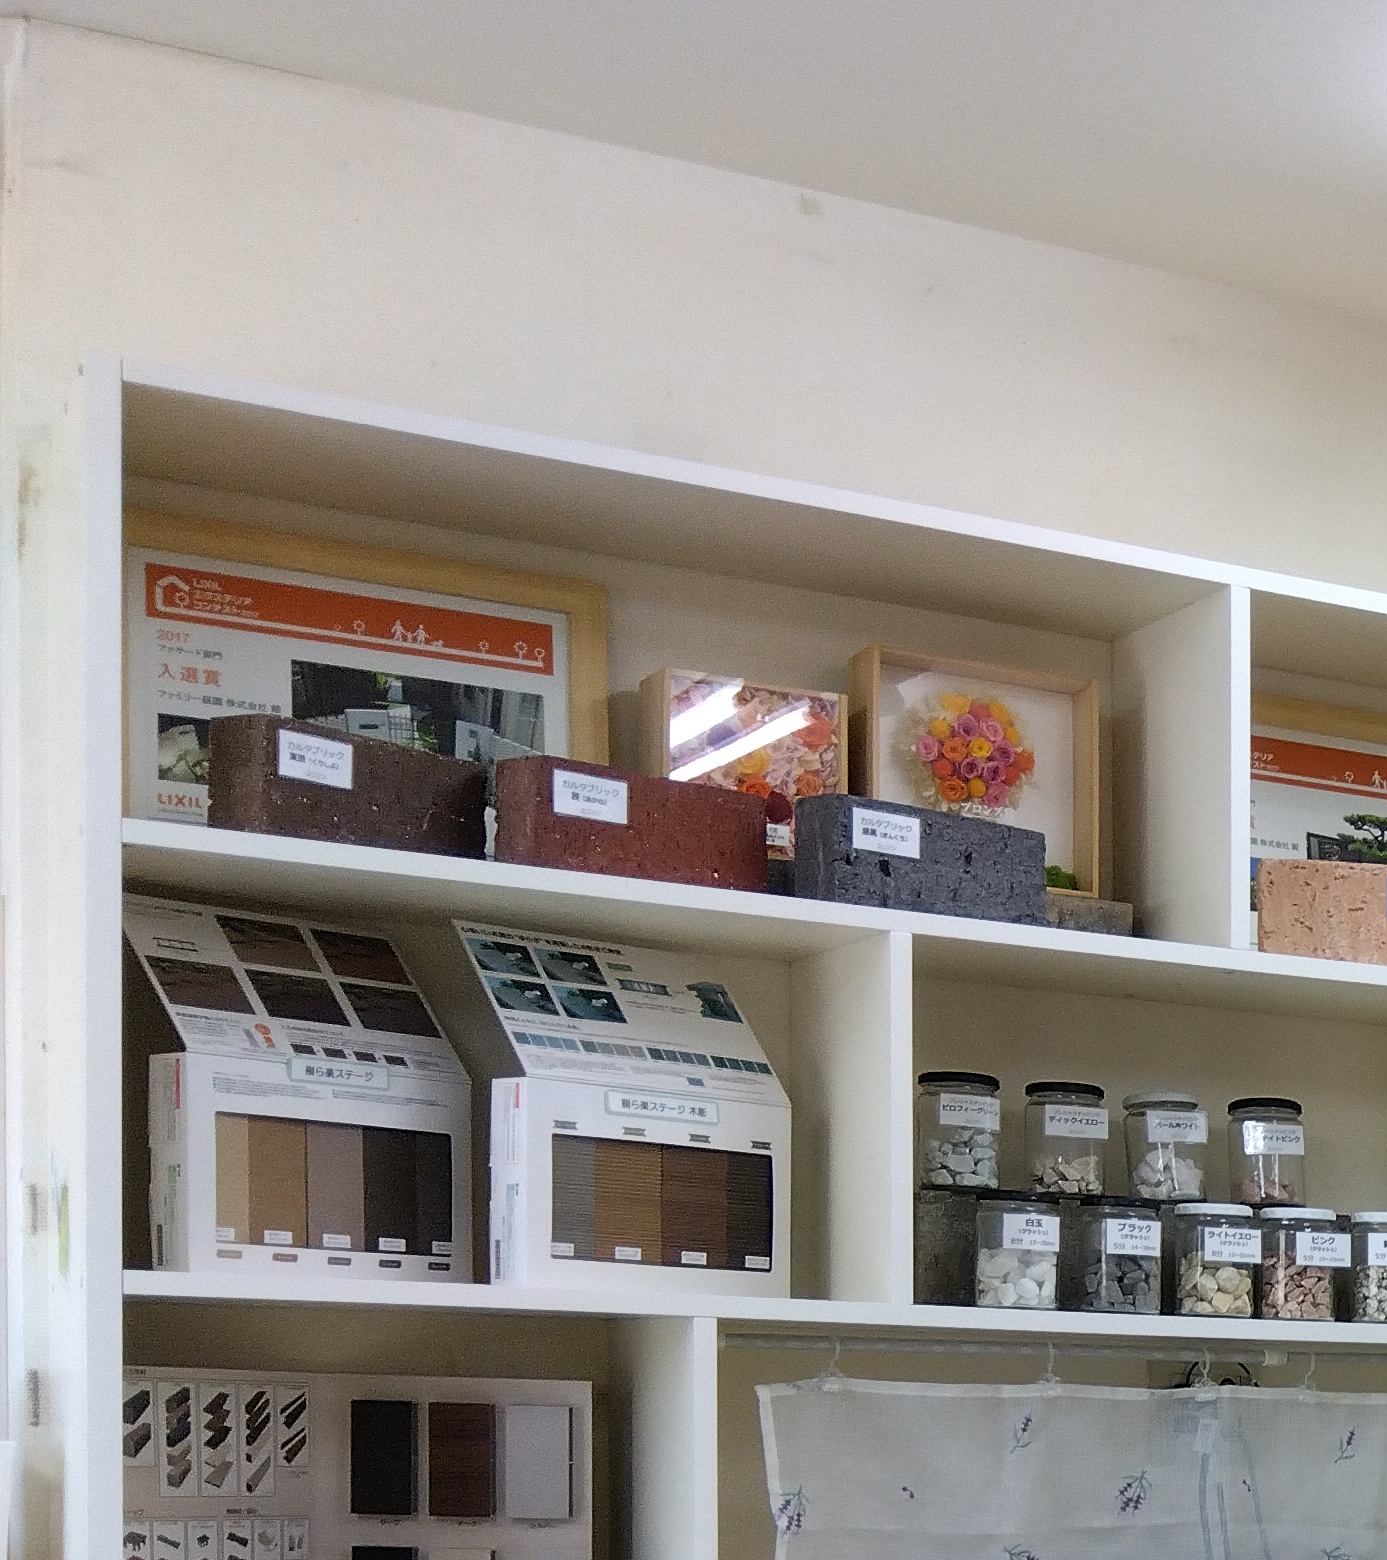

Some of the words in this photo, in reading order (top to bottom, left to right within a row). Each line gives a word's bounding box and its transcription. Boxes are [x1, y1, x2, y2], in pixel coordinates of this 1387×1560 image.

[157, 662, 222, 687] 入選賞
[1025, 1218, 1044, 1228] 白玉
[1117, 1222, 1152, 1233] ブラック
[1207, 1230, 1259, 1241] ライトイエロー
[1311, 1236, 1336, 1245] ピンク
